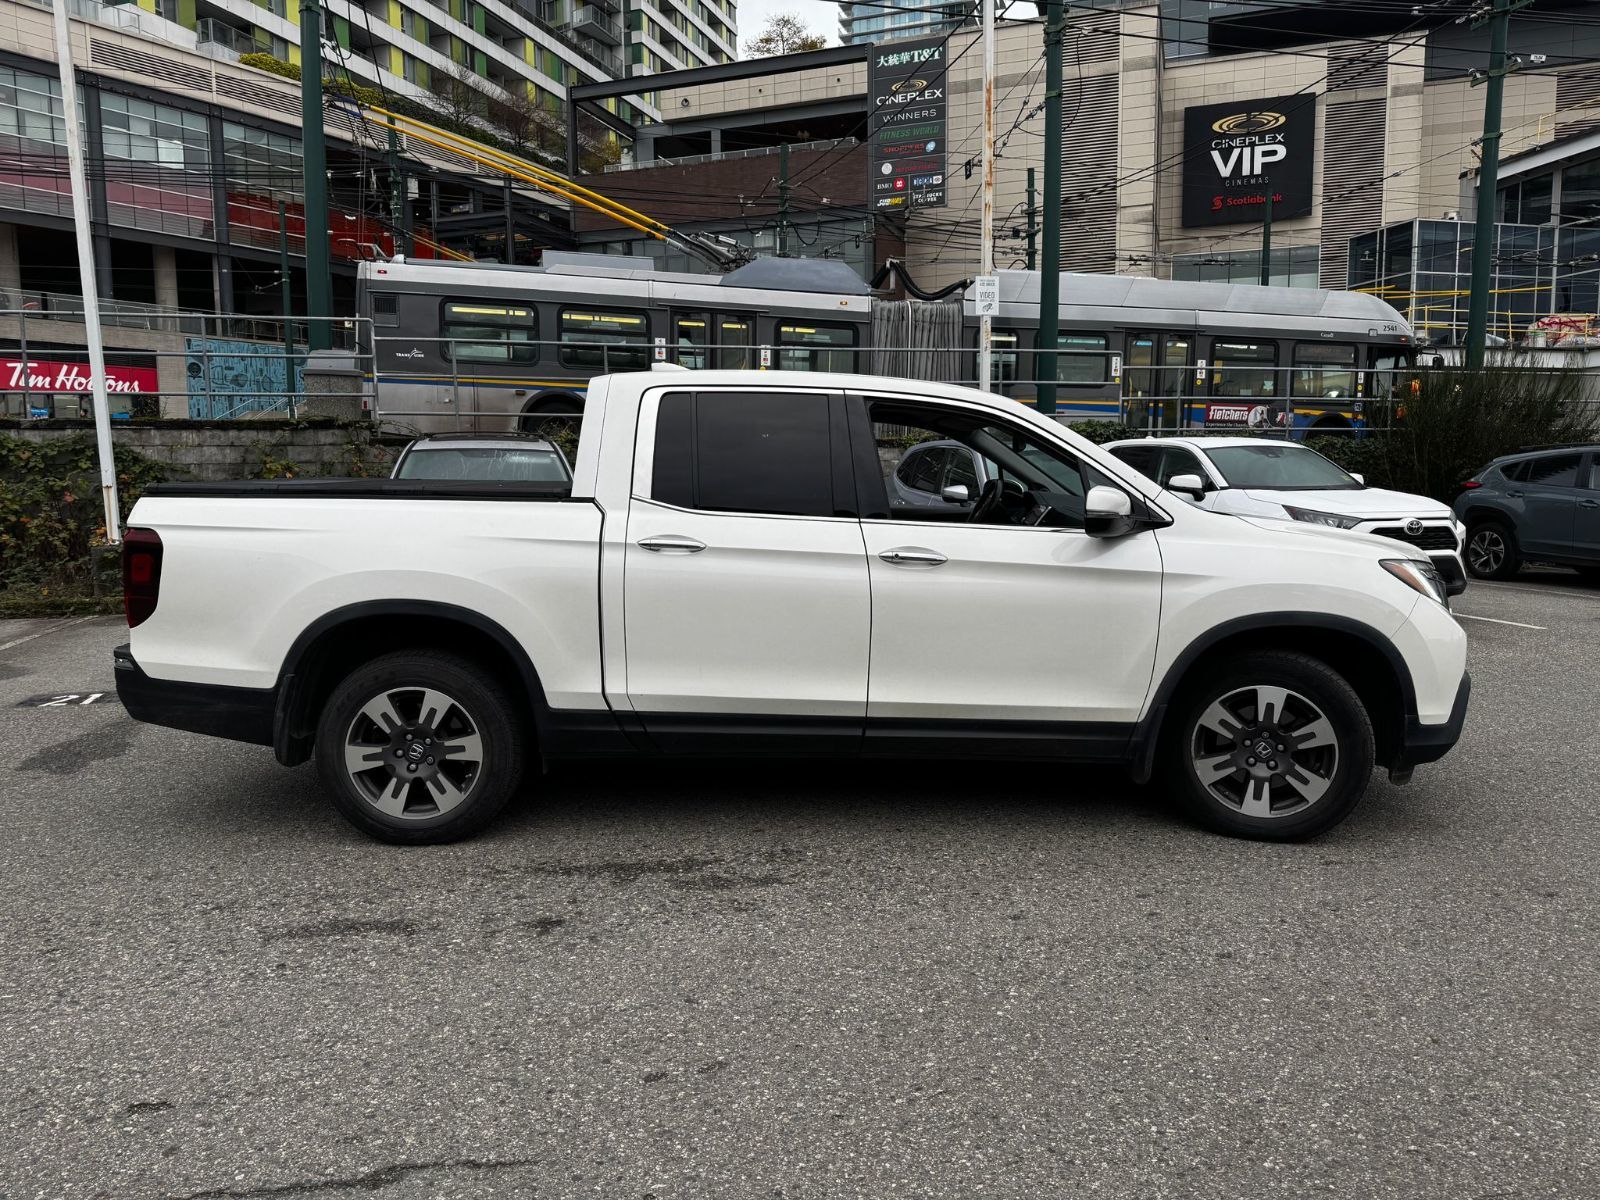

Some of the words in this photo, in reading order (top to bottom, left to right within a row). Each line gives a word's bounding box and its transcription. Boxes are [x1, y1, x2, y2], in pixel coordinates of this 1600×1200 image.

[876, 87, 943, 106] CINEPLEX
[883, 109, 937, 122] WINNERS
[879, 129, 911, 140] FITNESS
[912, 126, 940, 137] WORLD
[1211, 133, 1284, 148] CINEPLEX
[1210, 144, 1287, 178] VIP
[1225, 176, 1269, 187] CINEMAS
[1227, 193, 1282, 206] Scotiabnk
[1383, 324, 1398, 332] 2541
[6, 363, 51, 389] Tim
[54, 364, 140, 392] Hoons
[1209, 405, 1249, 420] Fletchers
